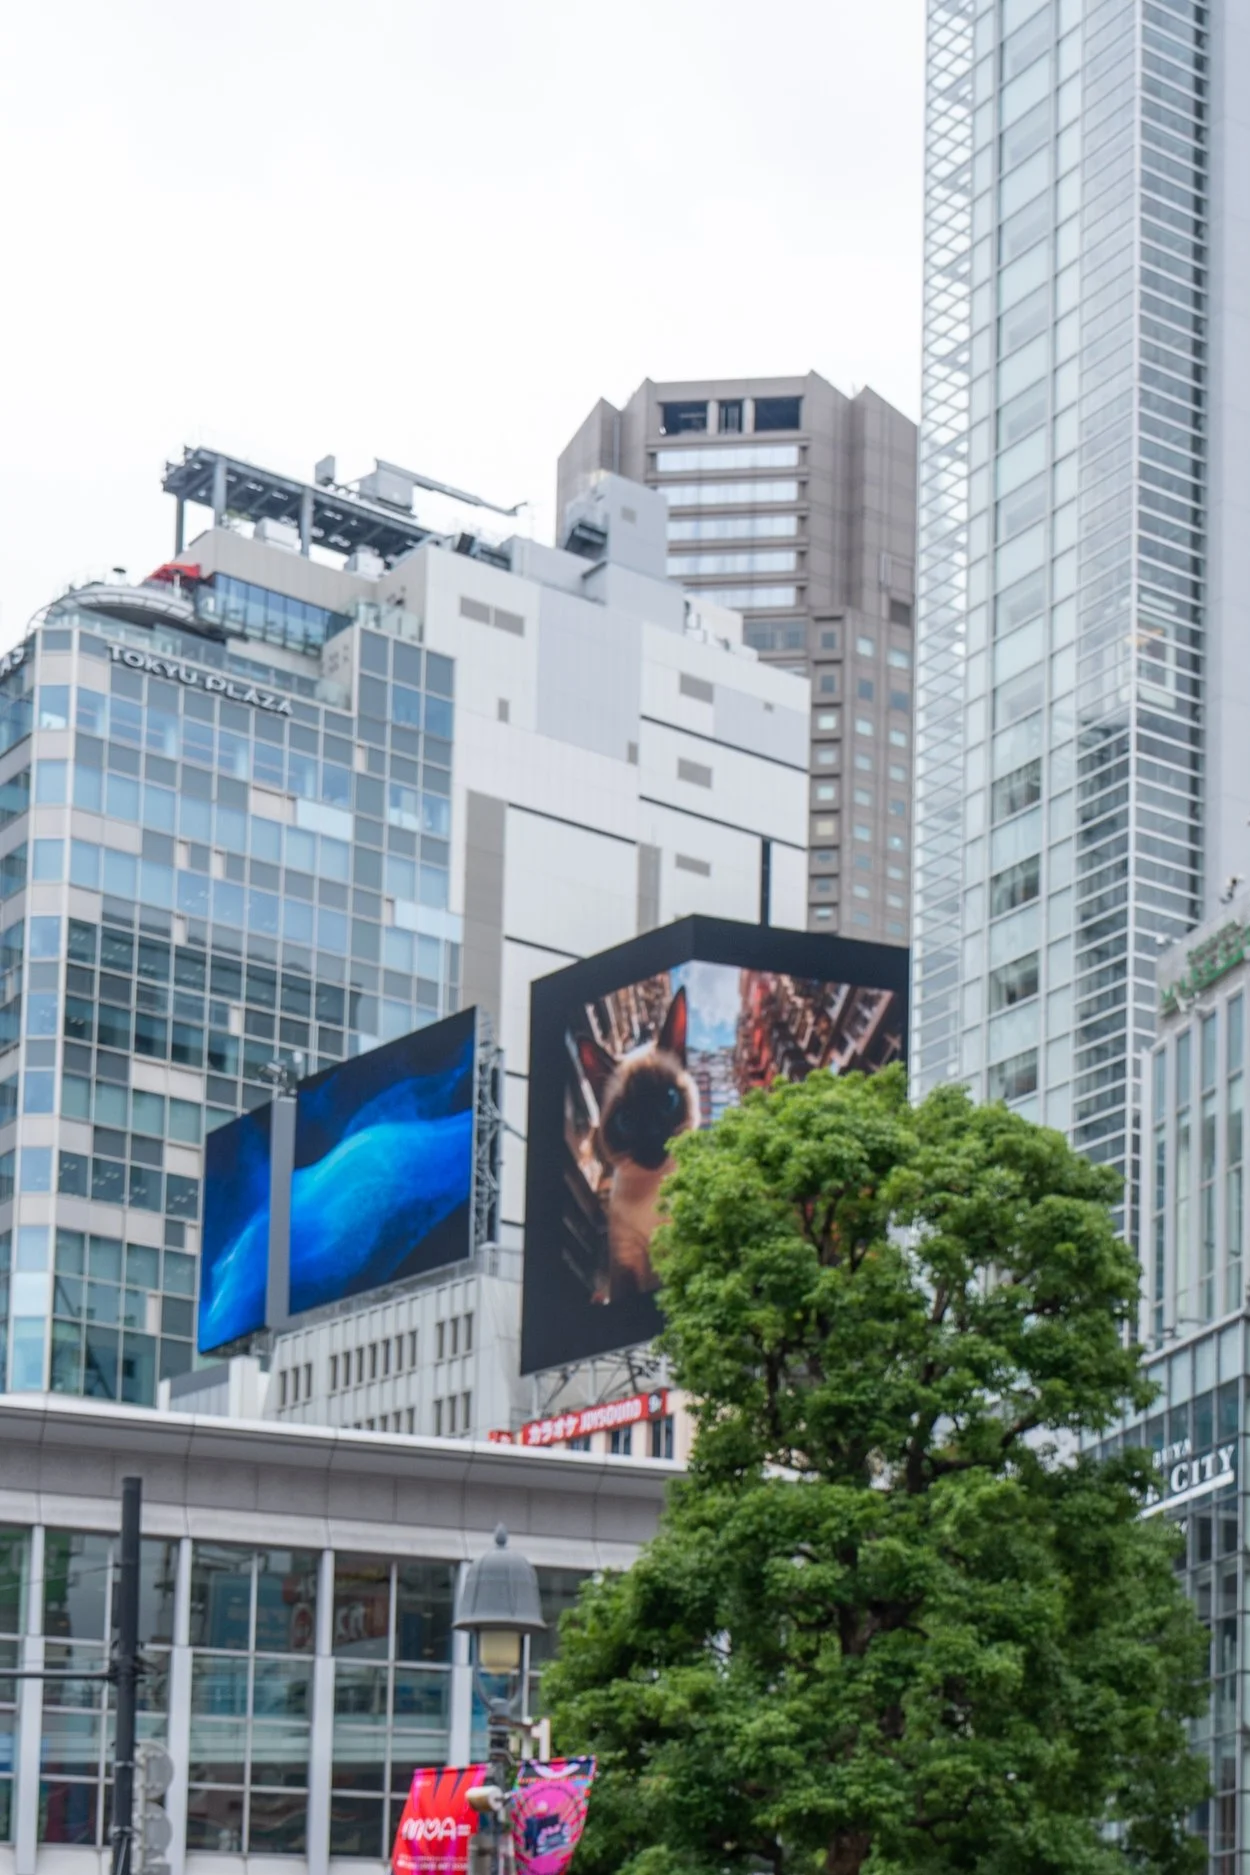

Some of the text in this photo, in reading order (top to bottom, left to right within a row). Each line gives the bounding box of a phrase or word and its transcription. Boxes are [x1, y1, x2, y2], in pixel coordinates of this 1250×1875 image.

[108, 643, 294, 717] TOKYU PLAZA
[1170, 1443, 1235, 1493] CITY
